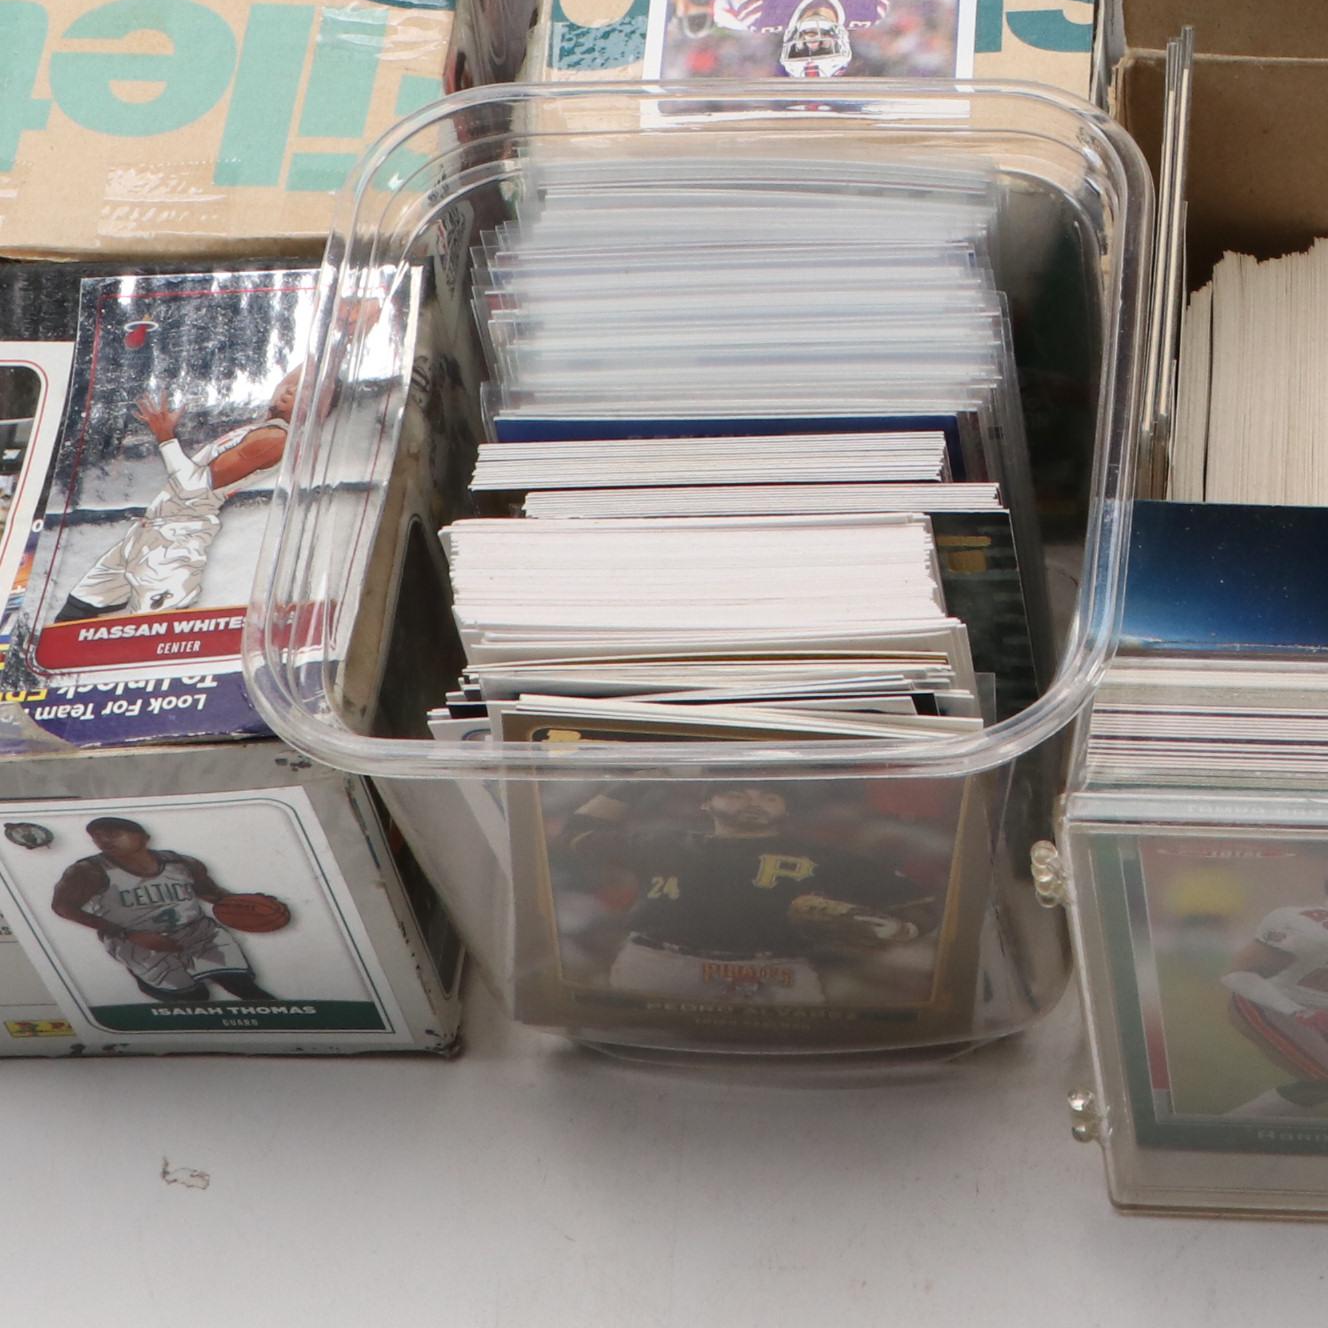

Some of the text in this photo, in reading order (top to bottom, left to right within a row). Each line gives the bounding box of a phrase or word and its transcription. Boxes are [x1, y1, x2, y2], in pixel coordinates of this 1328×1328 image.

[156, 640, 201, 655] CENTER
[34, 694, 207, 721] Look For Team
[119, 881, 194, 909] CELTICS
[151, 1006, 318, 1016] ISAIAH THOMAS
